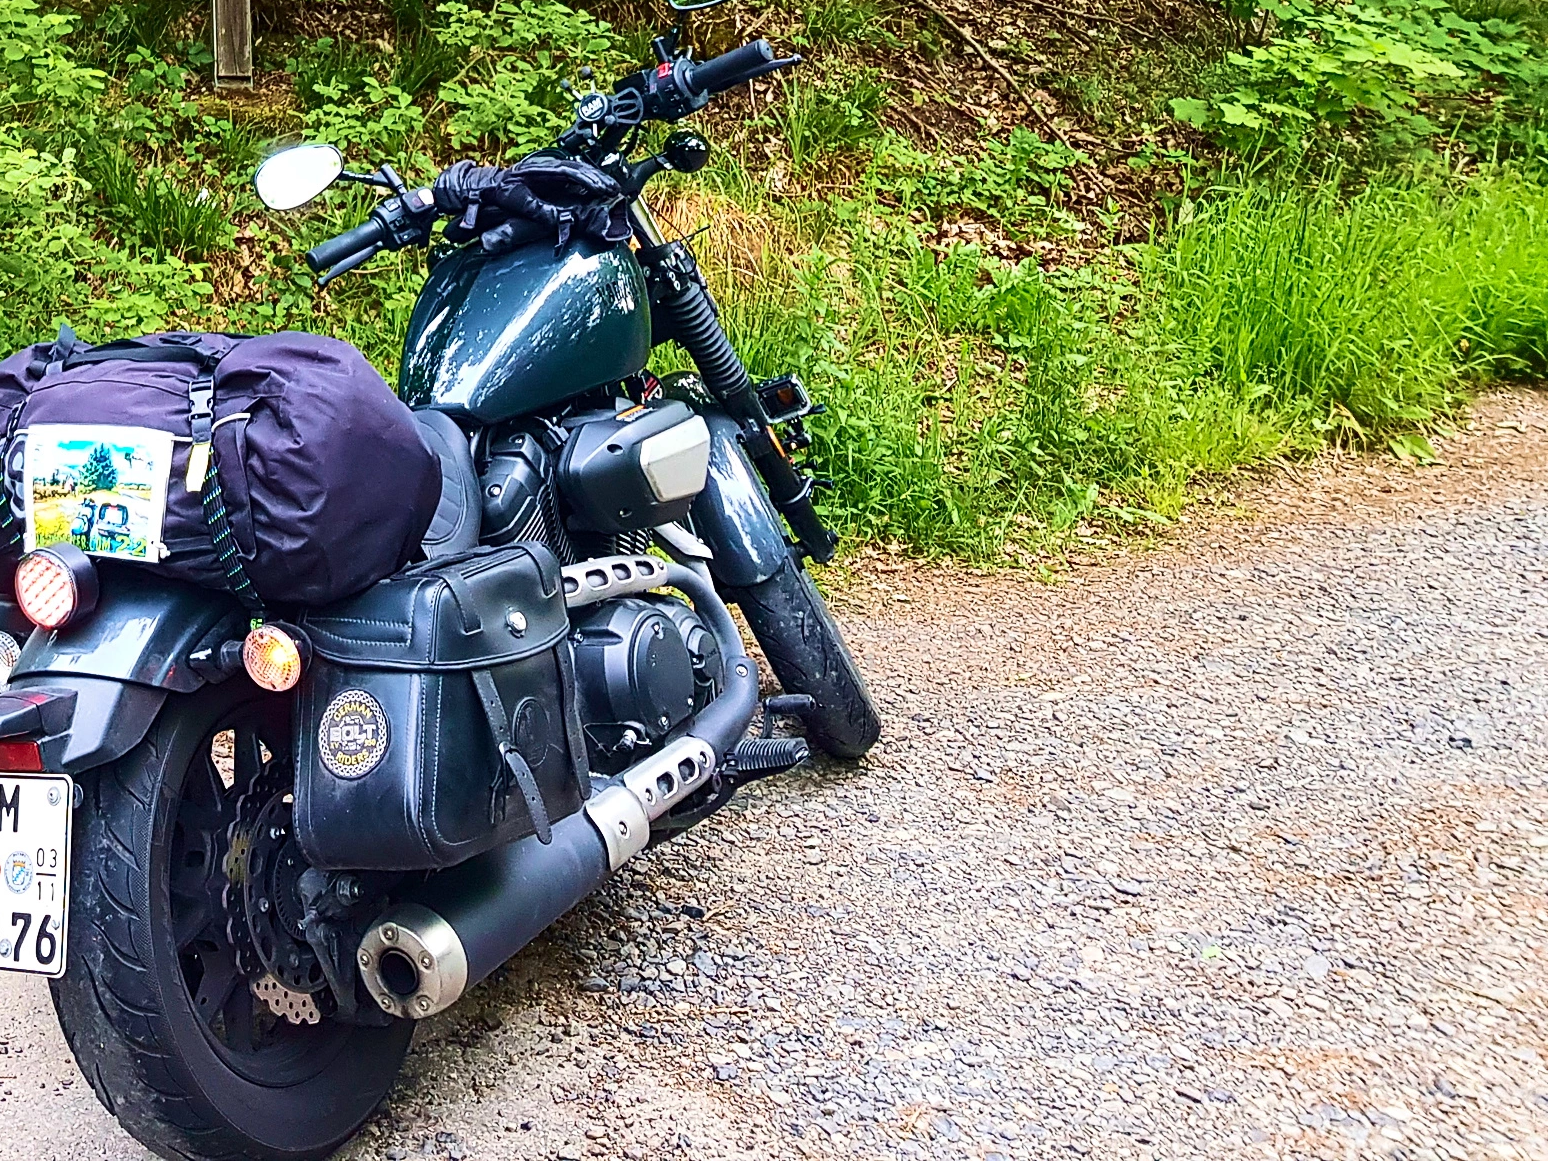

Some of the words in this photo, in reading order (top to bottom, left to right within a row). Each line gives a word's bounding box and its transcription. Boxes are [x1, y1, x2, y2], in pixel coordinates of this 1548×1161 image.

[333, 702, 373, 721] GERMAN
[329, 724, 377, 742] BOLT
[335, 749, 370, 765] RIDERS
[36, 847, 58, 868] 03
[37, 881, 55, 902] 11
